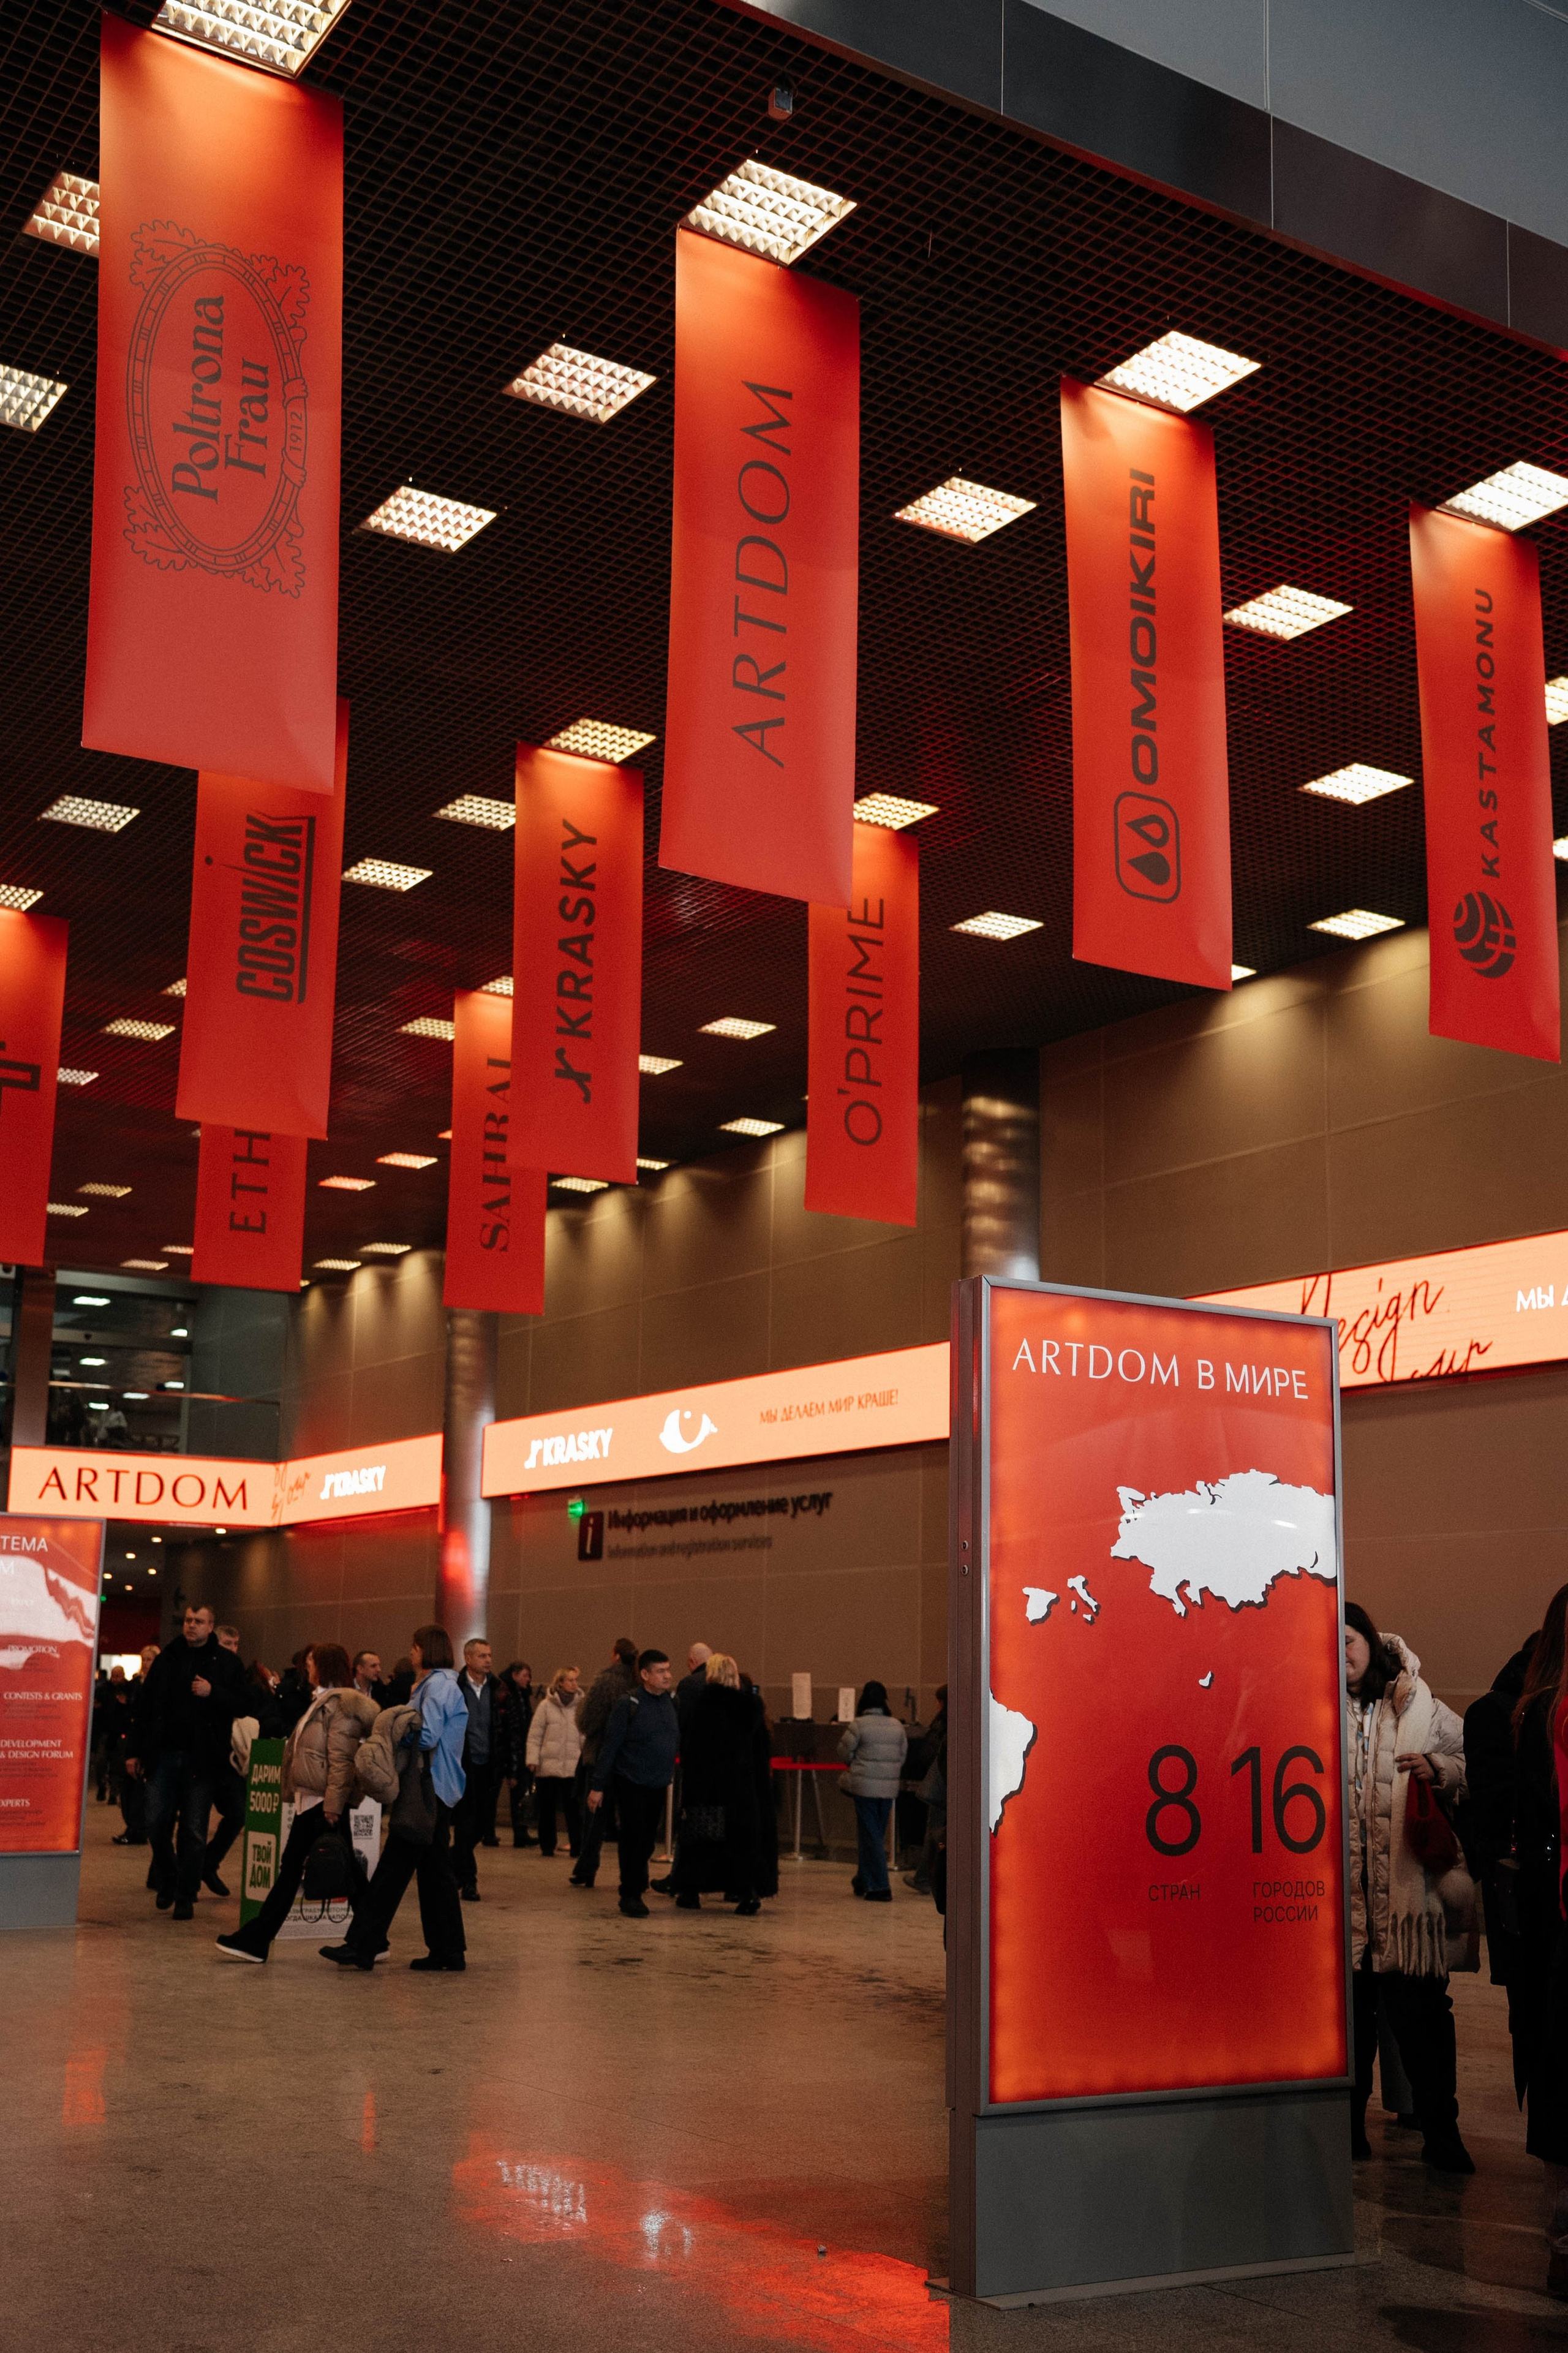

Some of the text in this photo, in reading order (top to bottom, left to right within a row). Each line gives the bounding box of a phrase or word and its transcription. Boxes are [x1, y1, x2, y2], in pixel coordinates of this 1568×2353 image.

[172, 295, 225, 504] Poltrona
[224, 358, 270, 477] Frau
[289, 410, 303, 451] 1912
[732, 380, 794, 768] ARTDOM
[1129, 468, 1159, 785] OMOIKIRI
[1475, 589, 1500, 878] KASTAMONU
[206, 811, 304, 1003] COSWICK
[556, 818, 597, 1040] KRASKY
[837, 898, 884, 1147] O'PRIME
[1516, 1284, 1555, 1312] МЫ
[1012, 1337, 1308, 1400] ARTDOM В МИРЕ
[760, 1388, 899, 1424] МЫ ДЕЛАЕМ МИР КРАШЕ!
[542, 1427, 613, 1466] KRASKY
[38, 1466, 247, 1511] ARTDOM
[333, 1465, 386, 1497] KRASKY
[608, 1492, 833, 1533] Информация и оформление услуг
[4, 1691, 42, 1700] CONTESTS
[0, 1739, 62, 1748] DEVELOPMENT
[251, 1764, 282, 1785] ДАРИМ
[1145, 1744, 1202, 1857] 8
[1231, 1745, 1327, 1854] 16
[252, 1840, 272, 1864] ТВОЙ
[249, 1864, 271, 1889] ДОМ
[1148, 1884, 1201, 1902] СТРАН
[1252, 1880, 1325, 1900] ГОРОДОВ
[1253, 1905, 1318, 1924] РОССИИ
